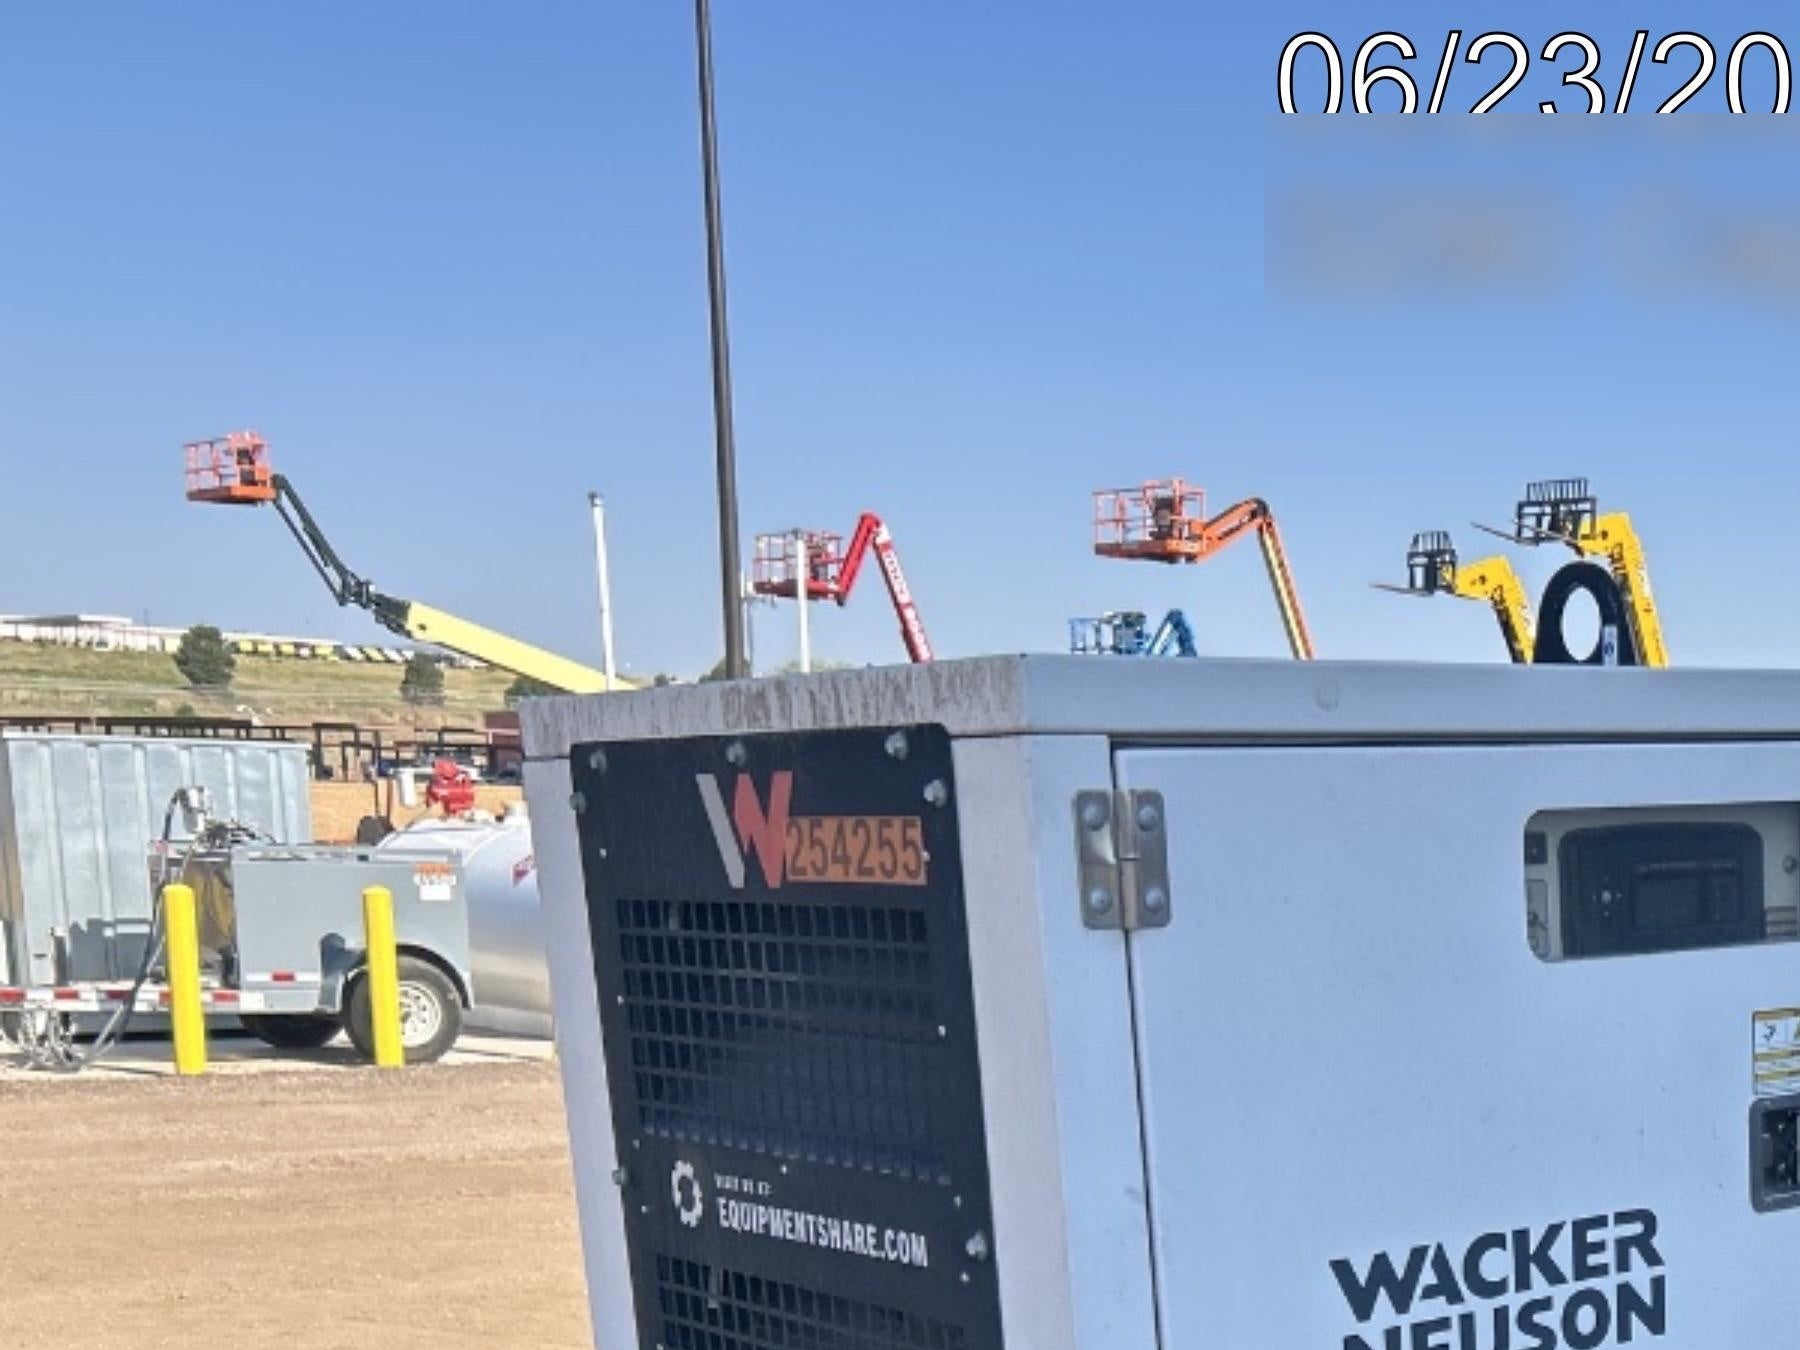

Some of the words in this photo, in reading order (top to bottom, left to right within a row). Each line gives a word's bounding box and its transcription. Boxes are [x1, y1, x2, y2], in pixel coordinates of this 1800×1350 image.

[786, 818, 922, 880] 254255
[717, 1197, 929, 1267] EQUIPMENTSHARE.COM
[1328, 1208, 1665, 1322] WACKER
